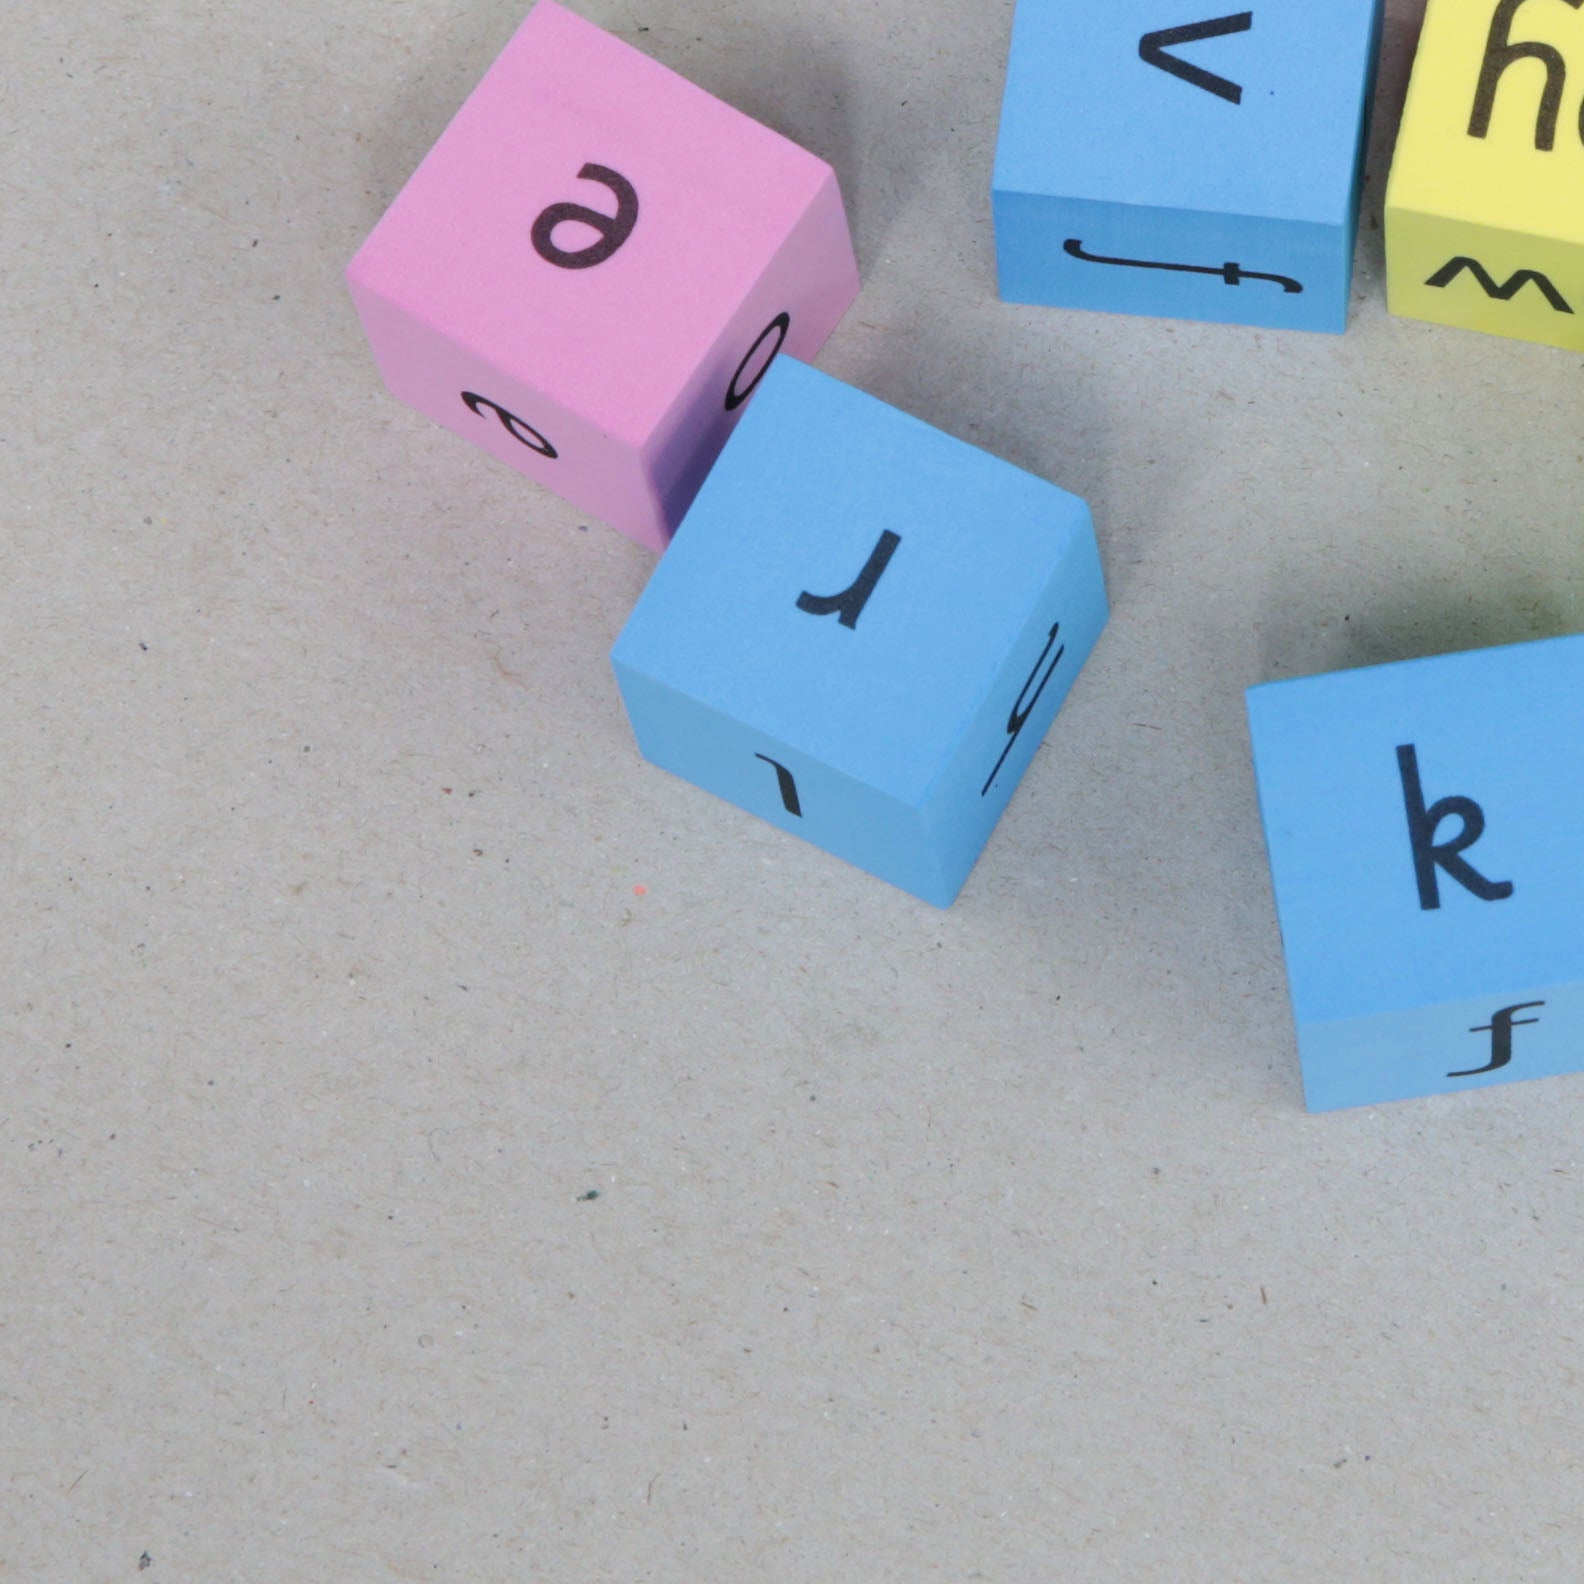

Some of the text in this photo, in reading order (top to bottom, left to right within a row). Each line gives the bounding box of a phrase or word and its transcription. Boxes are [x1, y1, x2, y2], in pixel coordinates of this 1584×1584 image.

[1140, 13, 1250, 103] v
[533, 165, 638, 268] e
[1399, 745, 1512, 909] k
[1446, 1000, 1545, 1078] f
